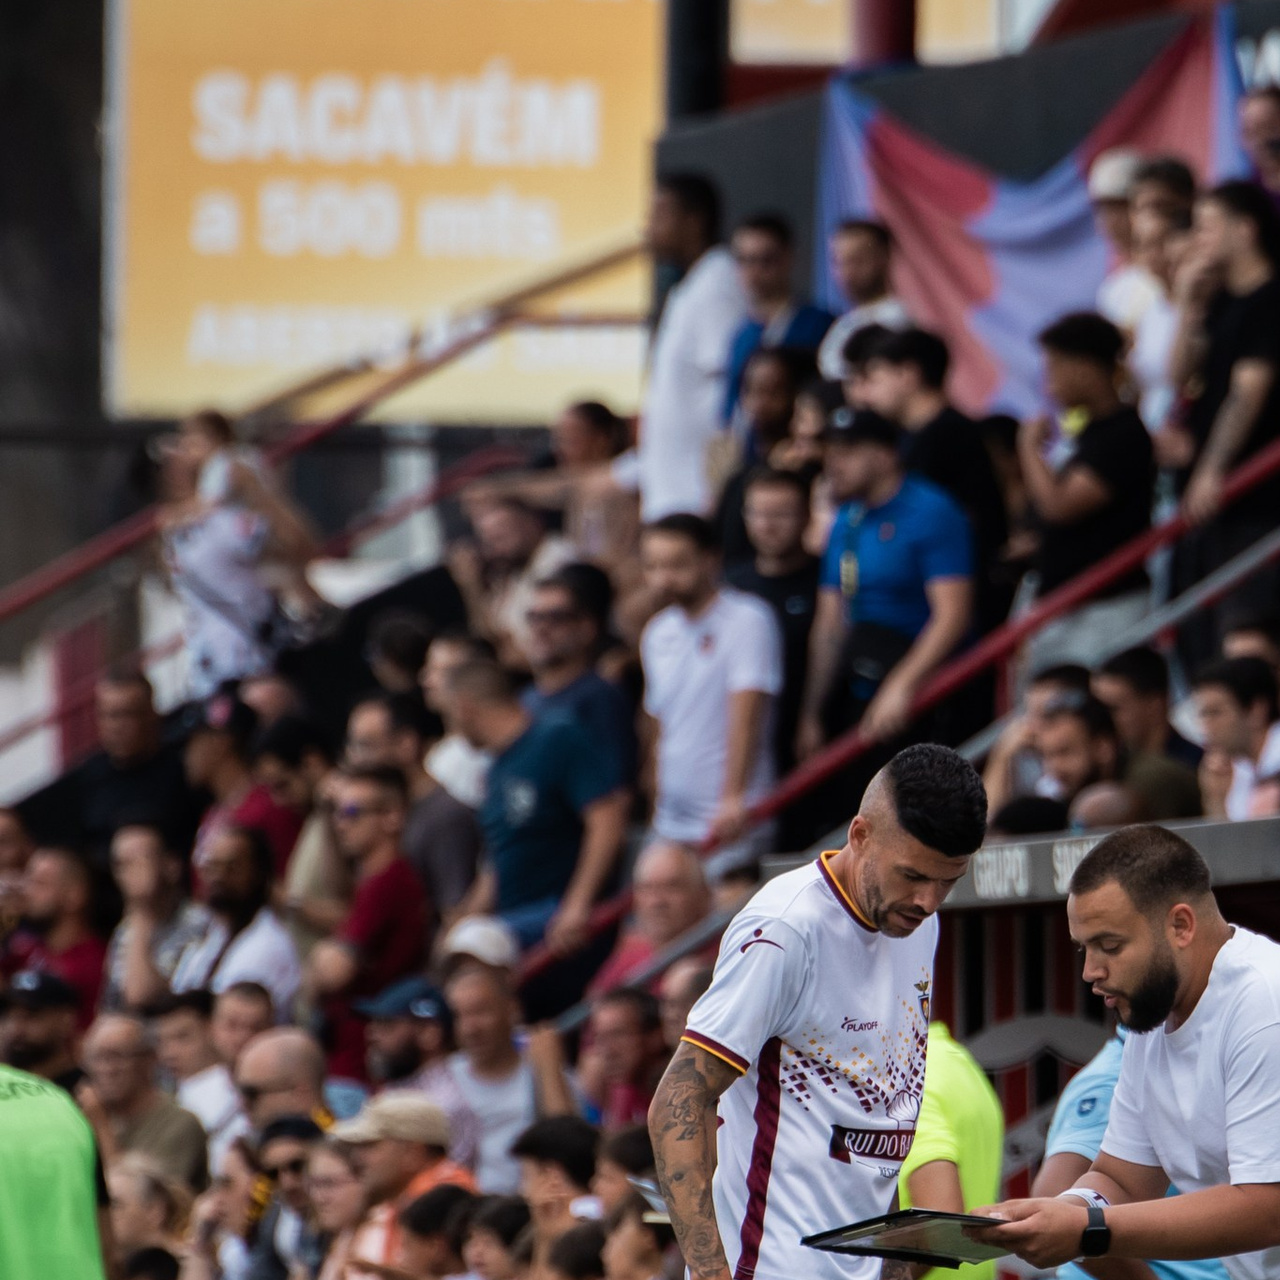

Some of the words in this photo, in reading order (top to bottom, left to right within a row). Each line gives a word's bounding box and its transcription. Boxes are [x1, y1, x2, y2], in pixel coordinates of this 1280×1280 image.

[190, 58, 597, 170] SACAVÉM
[190, 192, 242, 256] a
[256, 180, 398, 258] 500
[847, 1021, 878, 1032] PLAYOFF
[844, 1131, 875, 1153] RUI
[874, 1134, 898, 1156] DO
